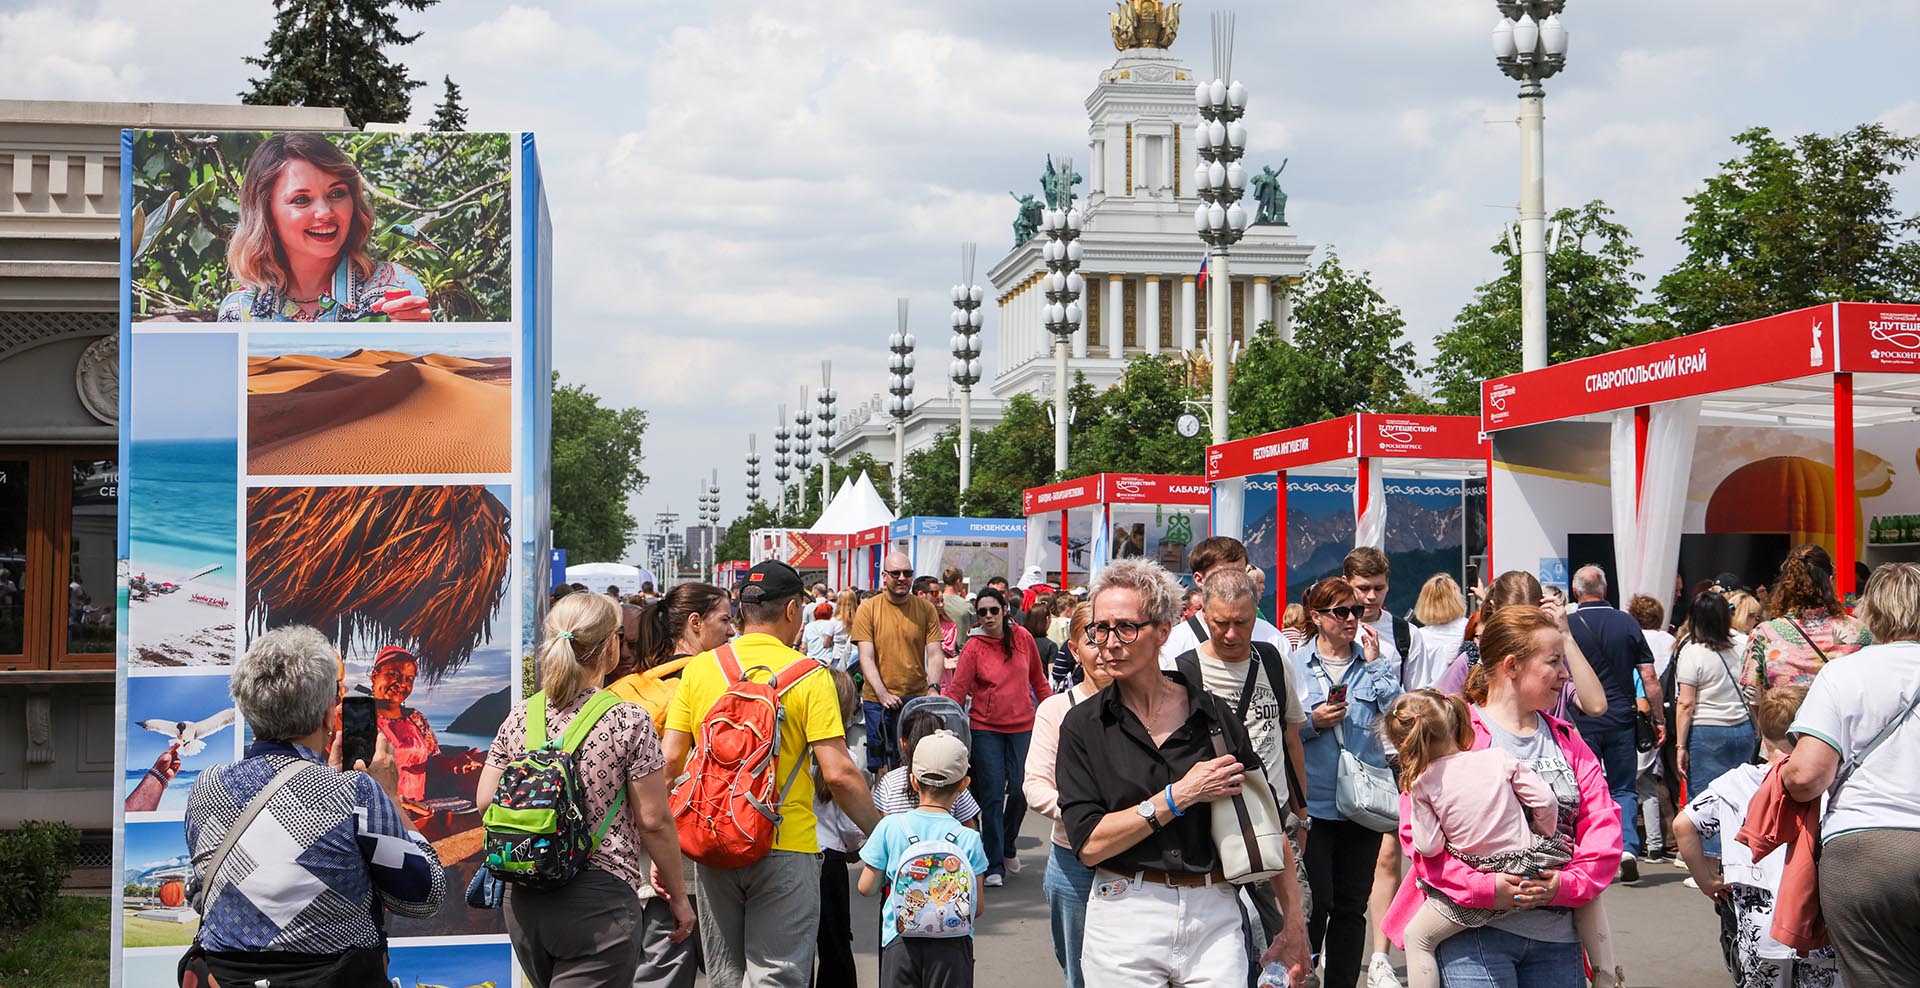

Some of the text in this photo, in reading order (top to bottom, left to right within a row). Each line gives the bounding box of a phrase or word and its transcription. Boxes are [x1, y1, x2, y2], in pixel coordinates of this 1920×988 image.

[1585, 347, 1707, 392] СТАВРОПОЛЬСКИЙ КРАЙ
[970, 523, 1021, 532] ПЕНЗЕНСКАЯ
